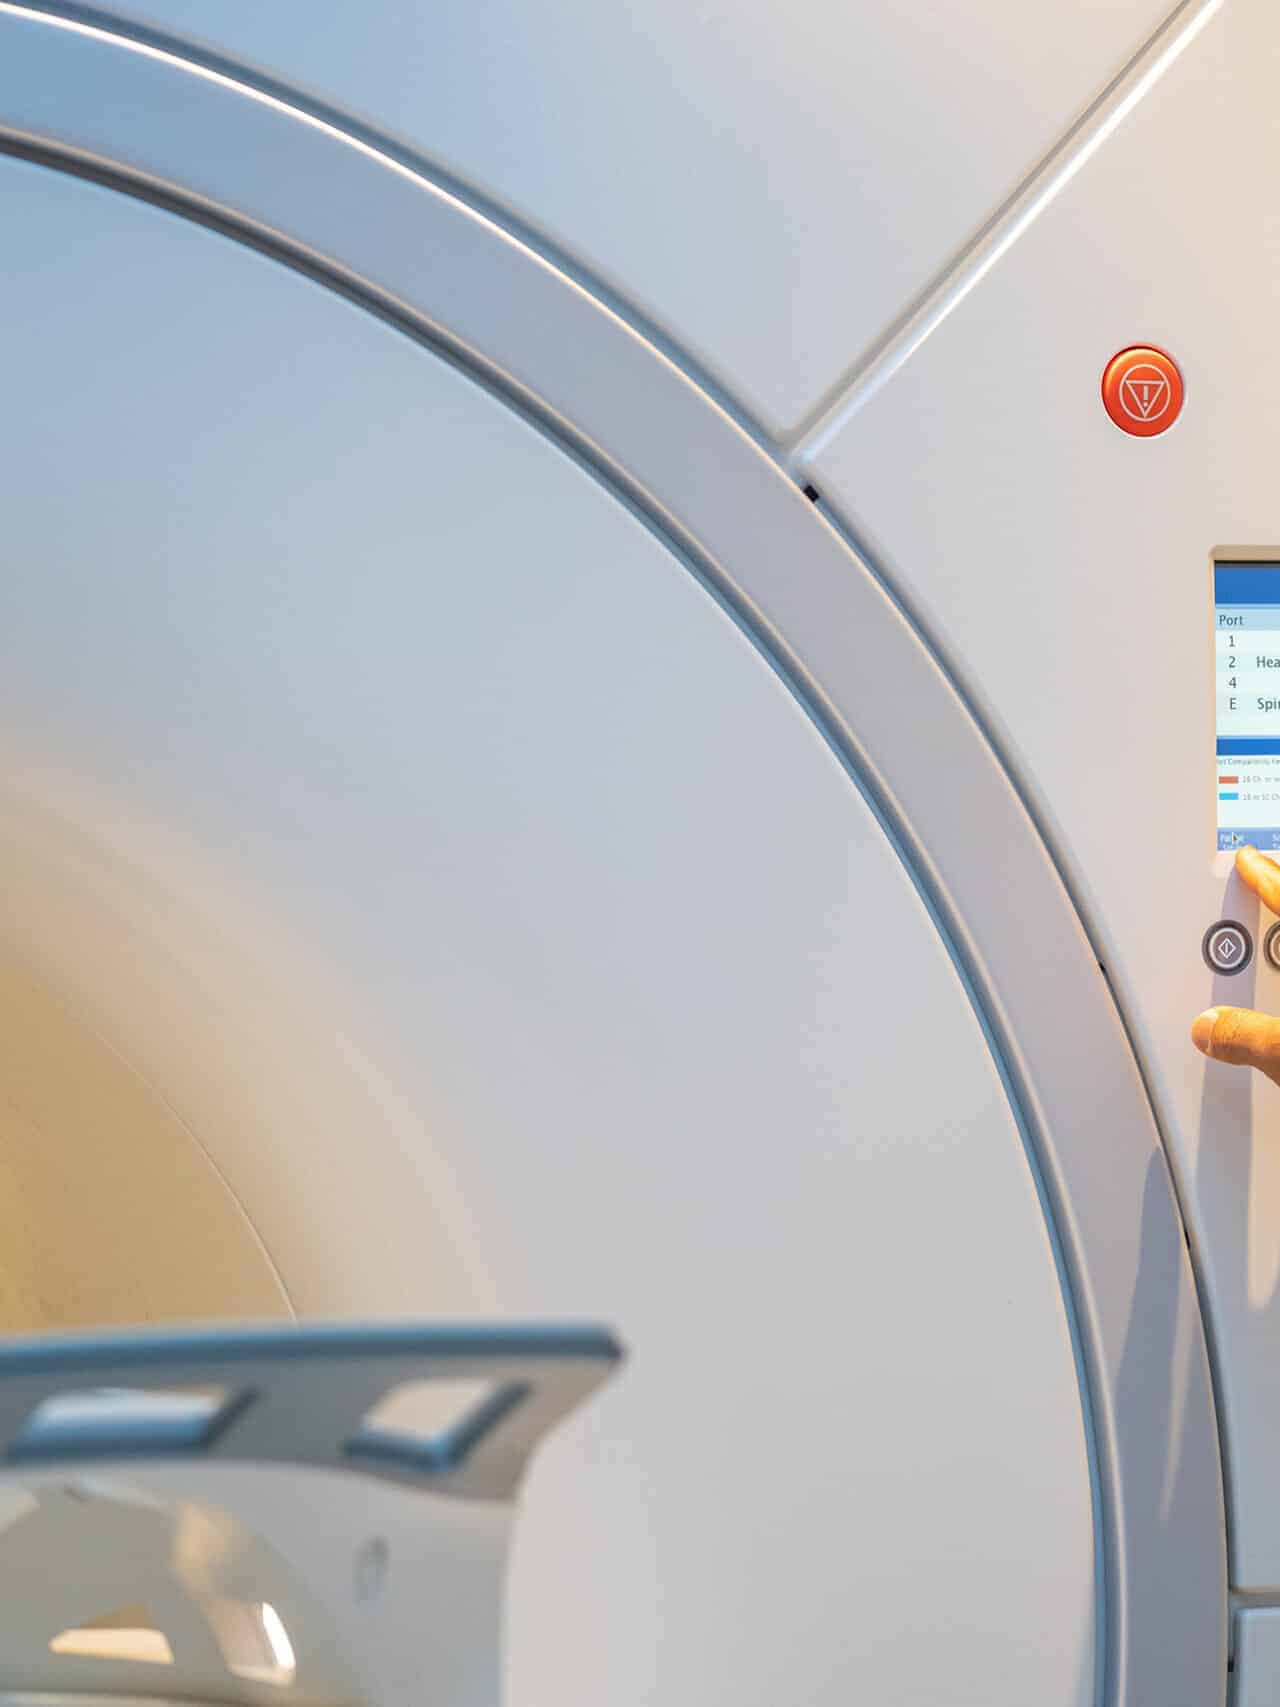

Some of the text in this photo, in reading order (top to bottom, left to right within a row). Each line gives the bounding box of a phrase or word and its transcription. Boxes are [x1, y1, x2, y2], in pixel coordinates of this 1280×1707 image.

[1219, 614, 1244, 626] Port
[1228, 635, 1236, 647] 1
[1228, 656, 1237, 668] 2
[1228, 676, 1238, 689] 4
[1229, 698, 1238, 710] E
